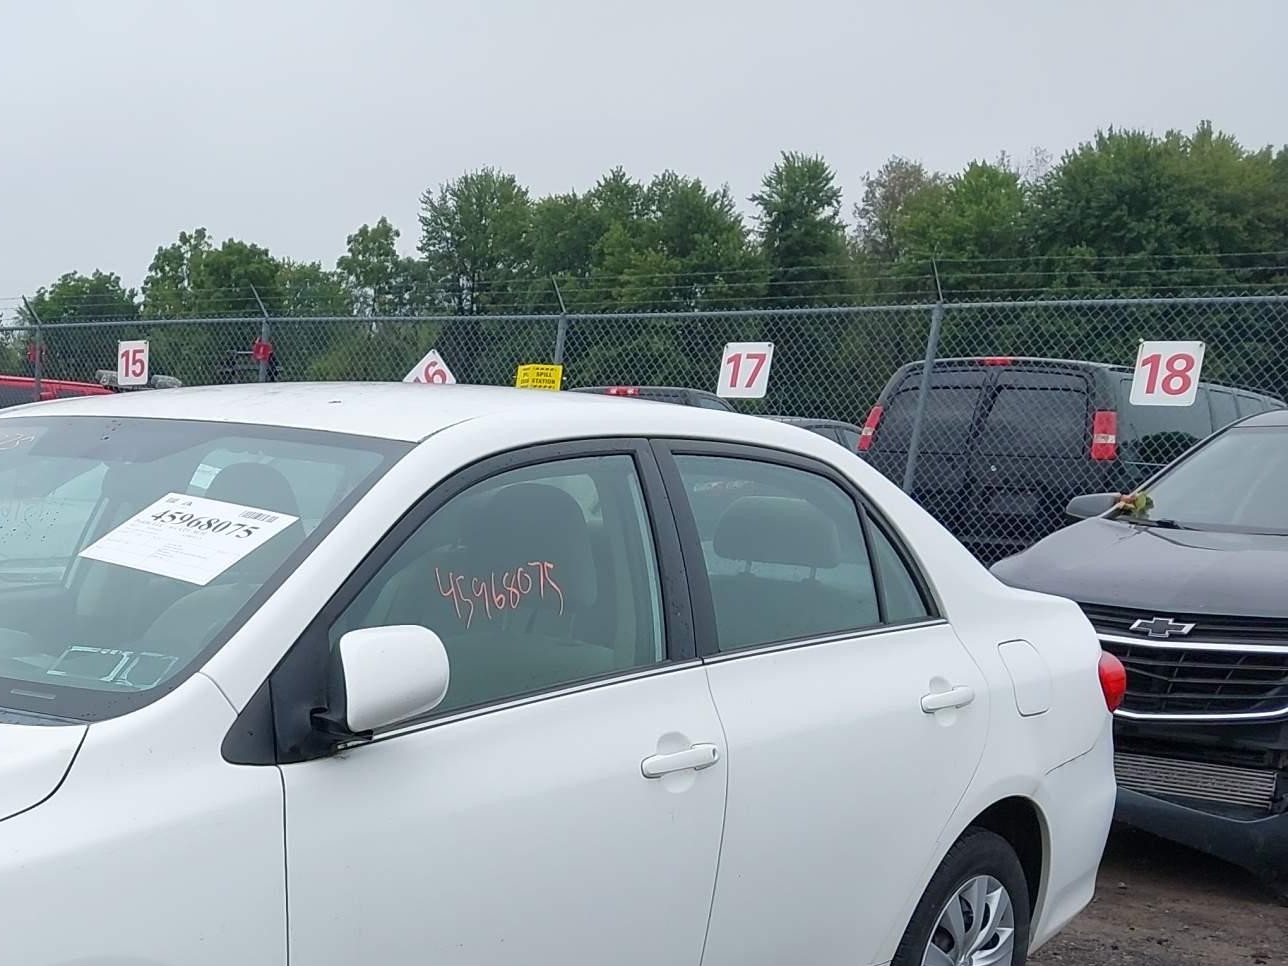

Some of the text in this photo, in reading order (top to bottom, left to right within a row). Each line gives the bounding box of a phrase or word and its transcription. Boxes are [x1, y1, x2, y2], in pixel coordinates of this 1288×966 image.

[121, 349, 145, 378] 15
[727, 353, 767, 388] 17
[1141, 353, 1195, 396] 18
[152, 510, 260, 539] 45968075
[435, 561, 563, 630] 45968075
